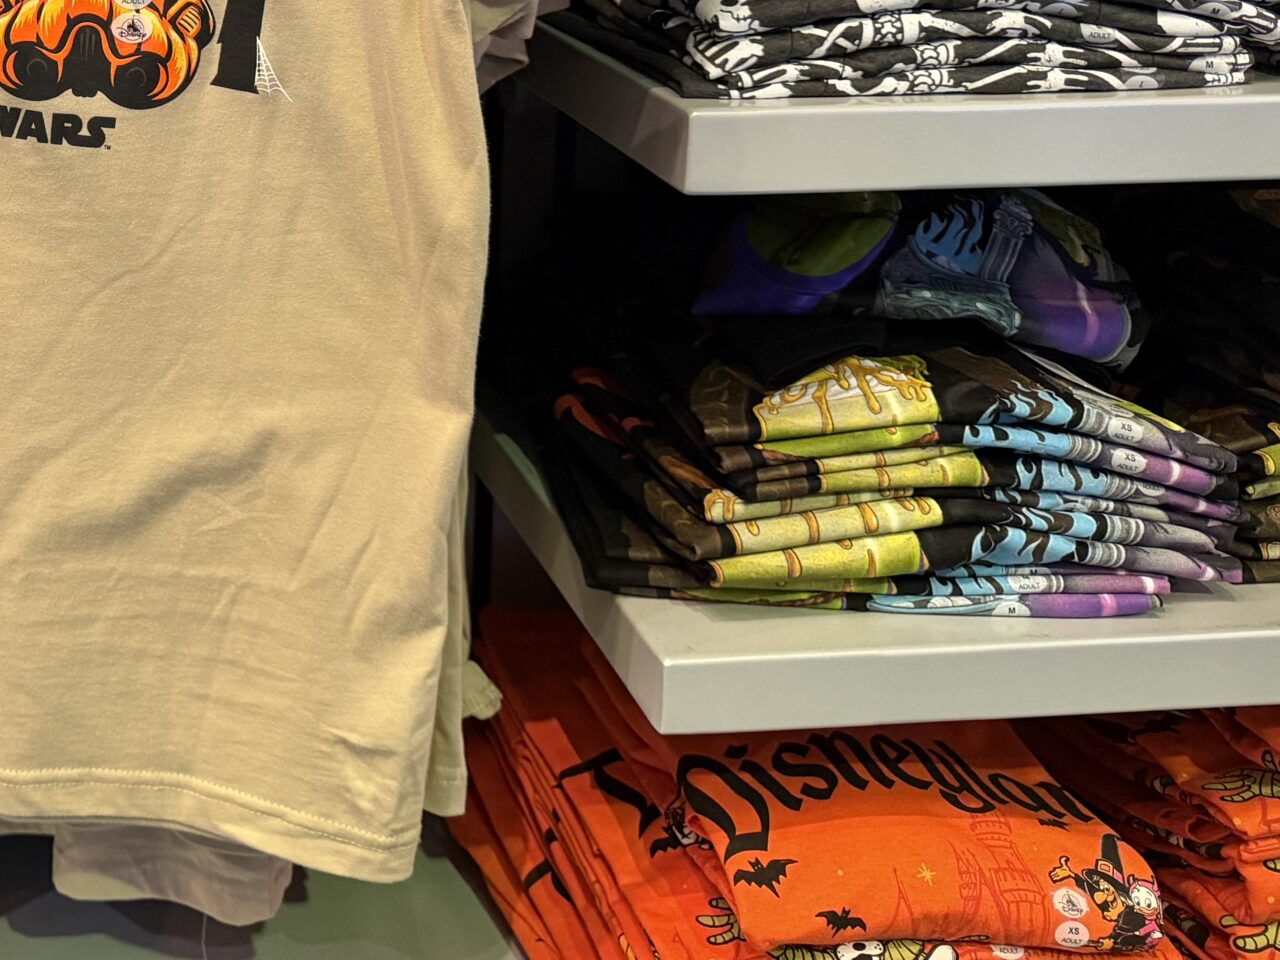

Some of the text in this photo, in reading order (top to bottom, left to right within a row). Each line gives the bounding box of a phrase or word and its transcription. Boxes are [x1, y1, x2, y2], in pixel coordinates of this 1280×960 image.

[1088, 30, 1111, 40] ADULT
[1205, 60, 1214, 69] M
[1120, 422, 1133, 432] XS
[1113, 431, 1135, 440] ADULT
[1124, 452, 1137, 462] XS
[1118, 462, 1138, 472] ADULT
[1018, 581, 1041, 590] ADULT
[1067, 927, 1080, 936] XS
[1061, 938, 1082, 946] ADULT
